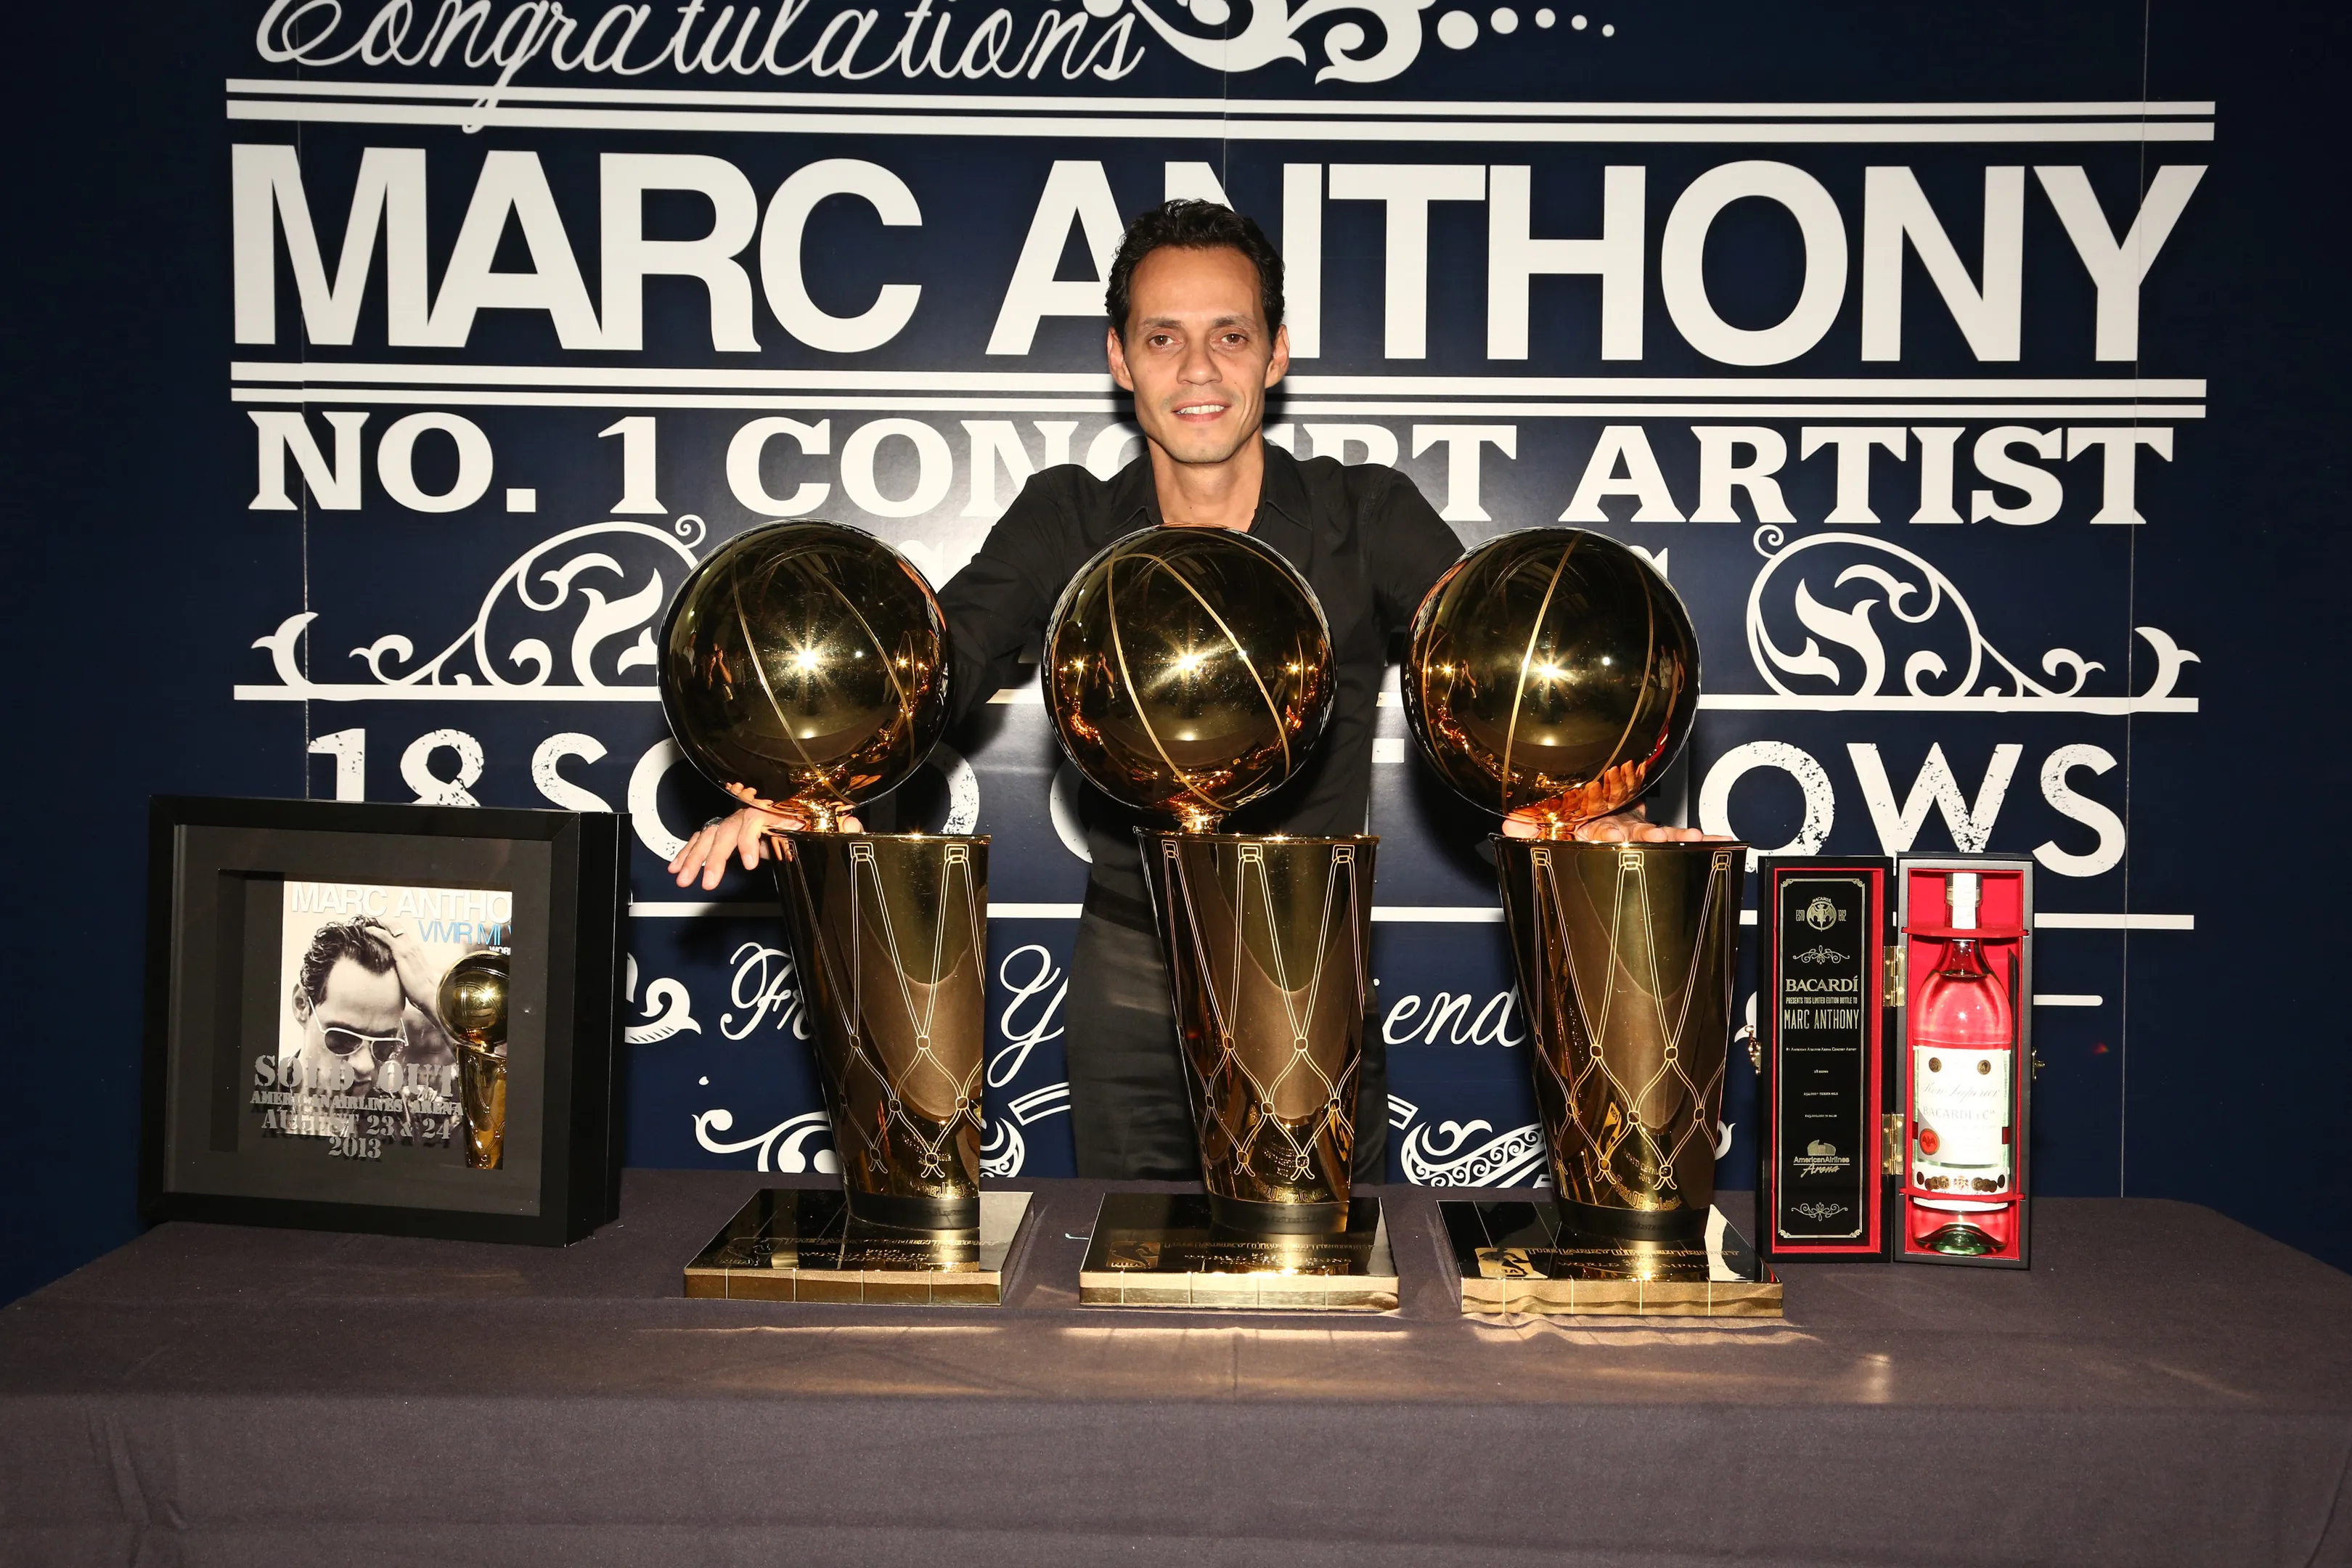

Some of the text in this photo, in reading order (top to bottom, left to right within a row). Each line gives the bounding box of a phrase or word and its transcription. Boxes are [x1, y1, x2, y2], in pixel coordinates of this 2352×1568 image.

[232, 144, 923, 354] MARC
[247, 411, 536, 513] NO.
[597, 416, 669, 514] 1
[1558, 425, 2173, 526] ARTIST
[308, 728, 484, 806] 18
[291, 881, 513, 924] MARC ANTHO
[418, 920, 473, 944] VIVIR
[477, 923, 502, 946] MI
[1785, 975, 1858, 992] BACARDÍ
[1784, 1009, 1860, 1029] MARC ANTHONY
[254, 1054, 459, 1098] SOLD OUT
[411, 1100, 465, 1116] ARENA
[261, 1108, 451, 1140] AUGUST 23 & 24
[328, 1136, 382, 1159] 2013
[1800, 1163, 1840, 1177] Arena
